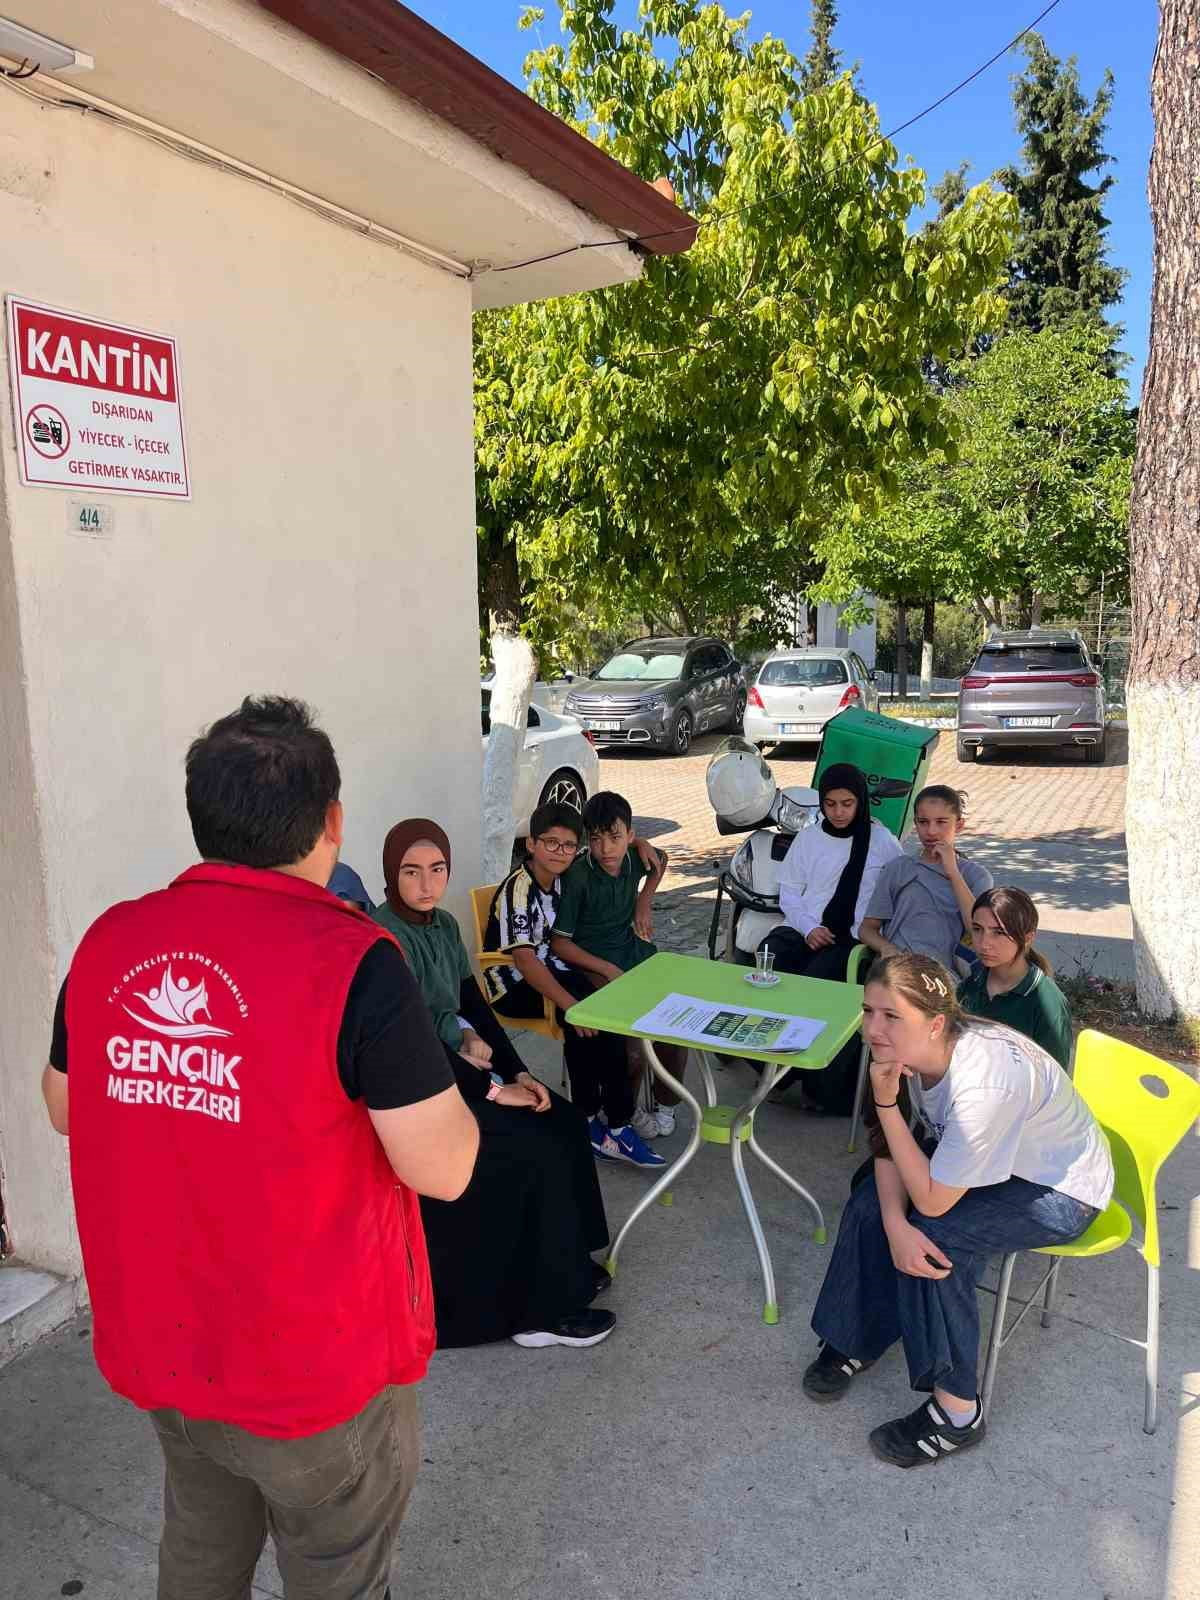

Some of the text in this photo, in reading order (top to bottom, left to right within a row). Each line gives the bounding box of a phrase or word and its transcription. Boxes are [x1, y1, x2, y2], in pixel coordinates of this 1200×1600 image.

[27, 328, 169, 395] KANTİN
[92, 401, 153, 423] DIŞARIDAN
[78, 428, 125, 449] YİYECEK
[134, 434, 171, 455] İÇECEK
[68, 460, 185, 486] GETİRMEK YASAKTIR.
[80, 508, 99, 527] 4/4
[172, 952, 185, 960] VE
[106, 1036, 243, 1090] GENÇLİK
[106, 1074, 241, 1123] MERKEZLERİ
